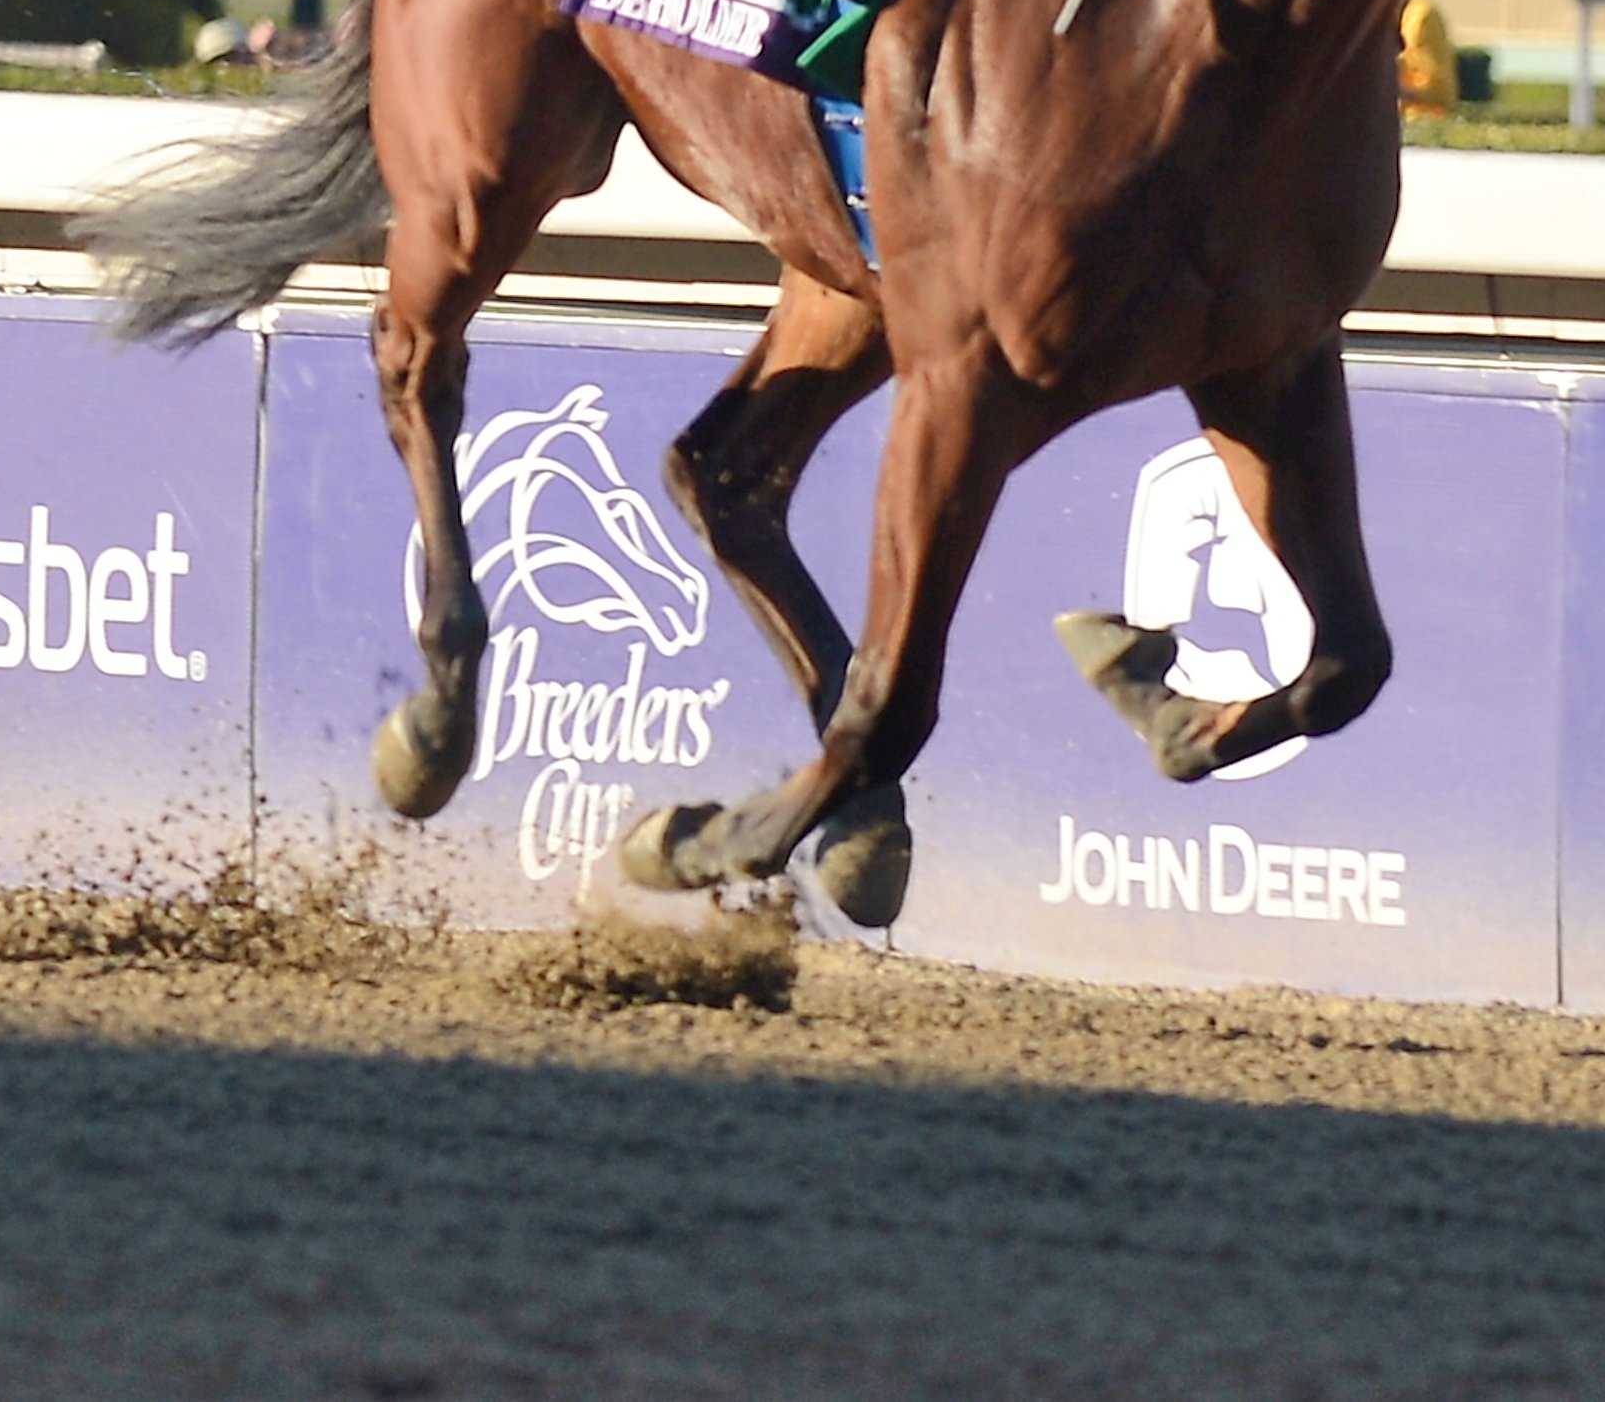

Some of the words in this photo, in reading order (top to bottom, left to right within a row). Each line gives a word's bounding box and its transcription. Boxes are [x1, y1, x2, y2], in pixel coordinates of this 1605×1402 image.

[518, 757, 621, 904] Cup
[1039, 815, 1200, 913] JOHN
[1208, 823, 1406, 926] DEERE
